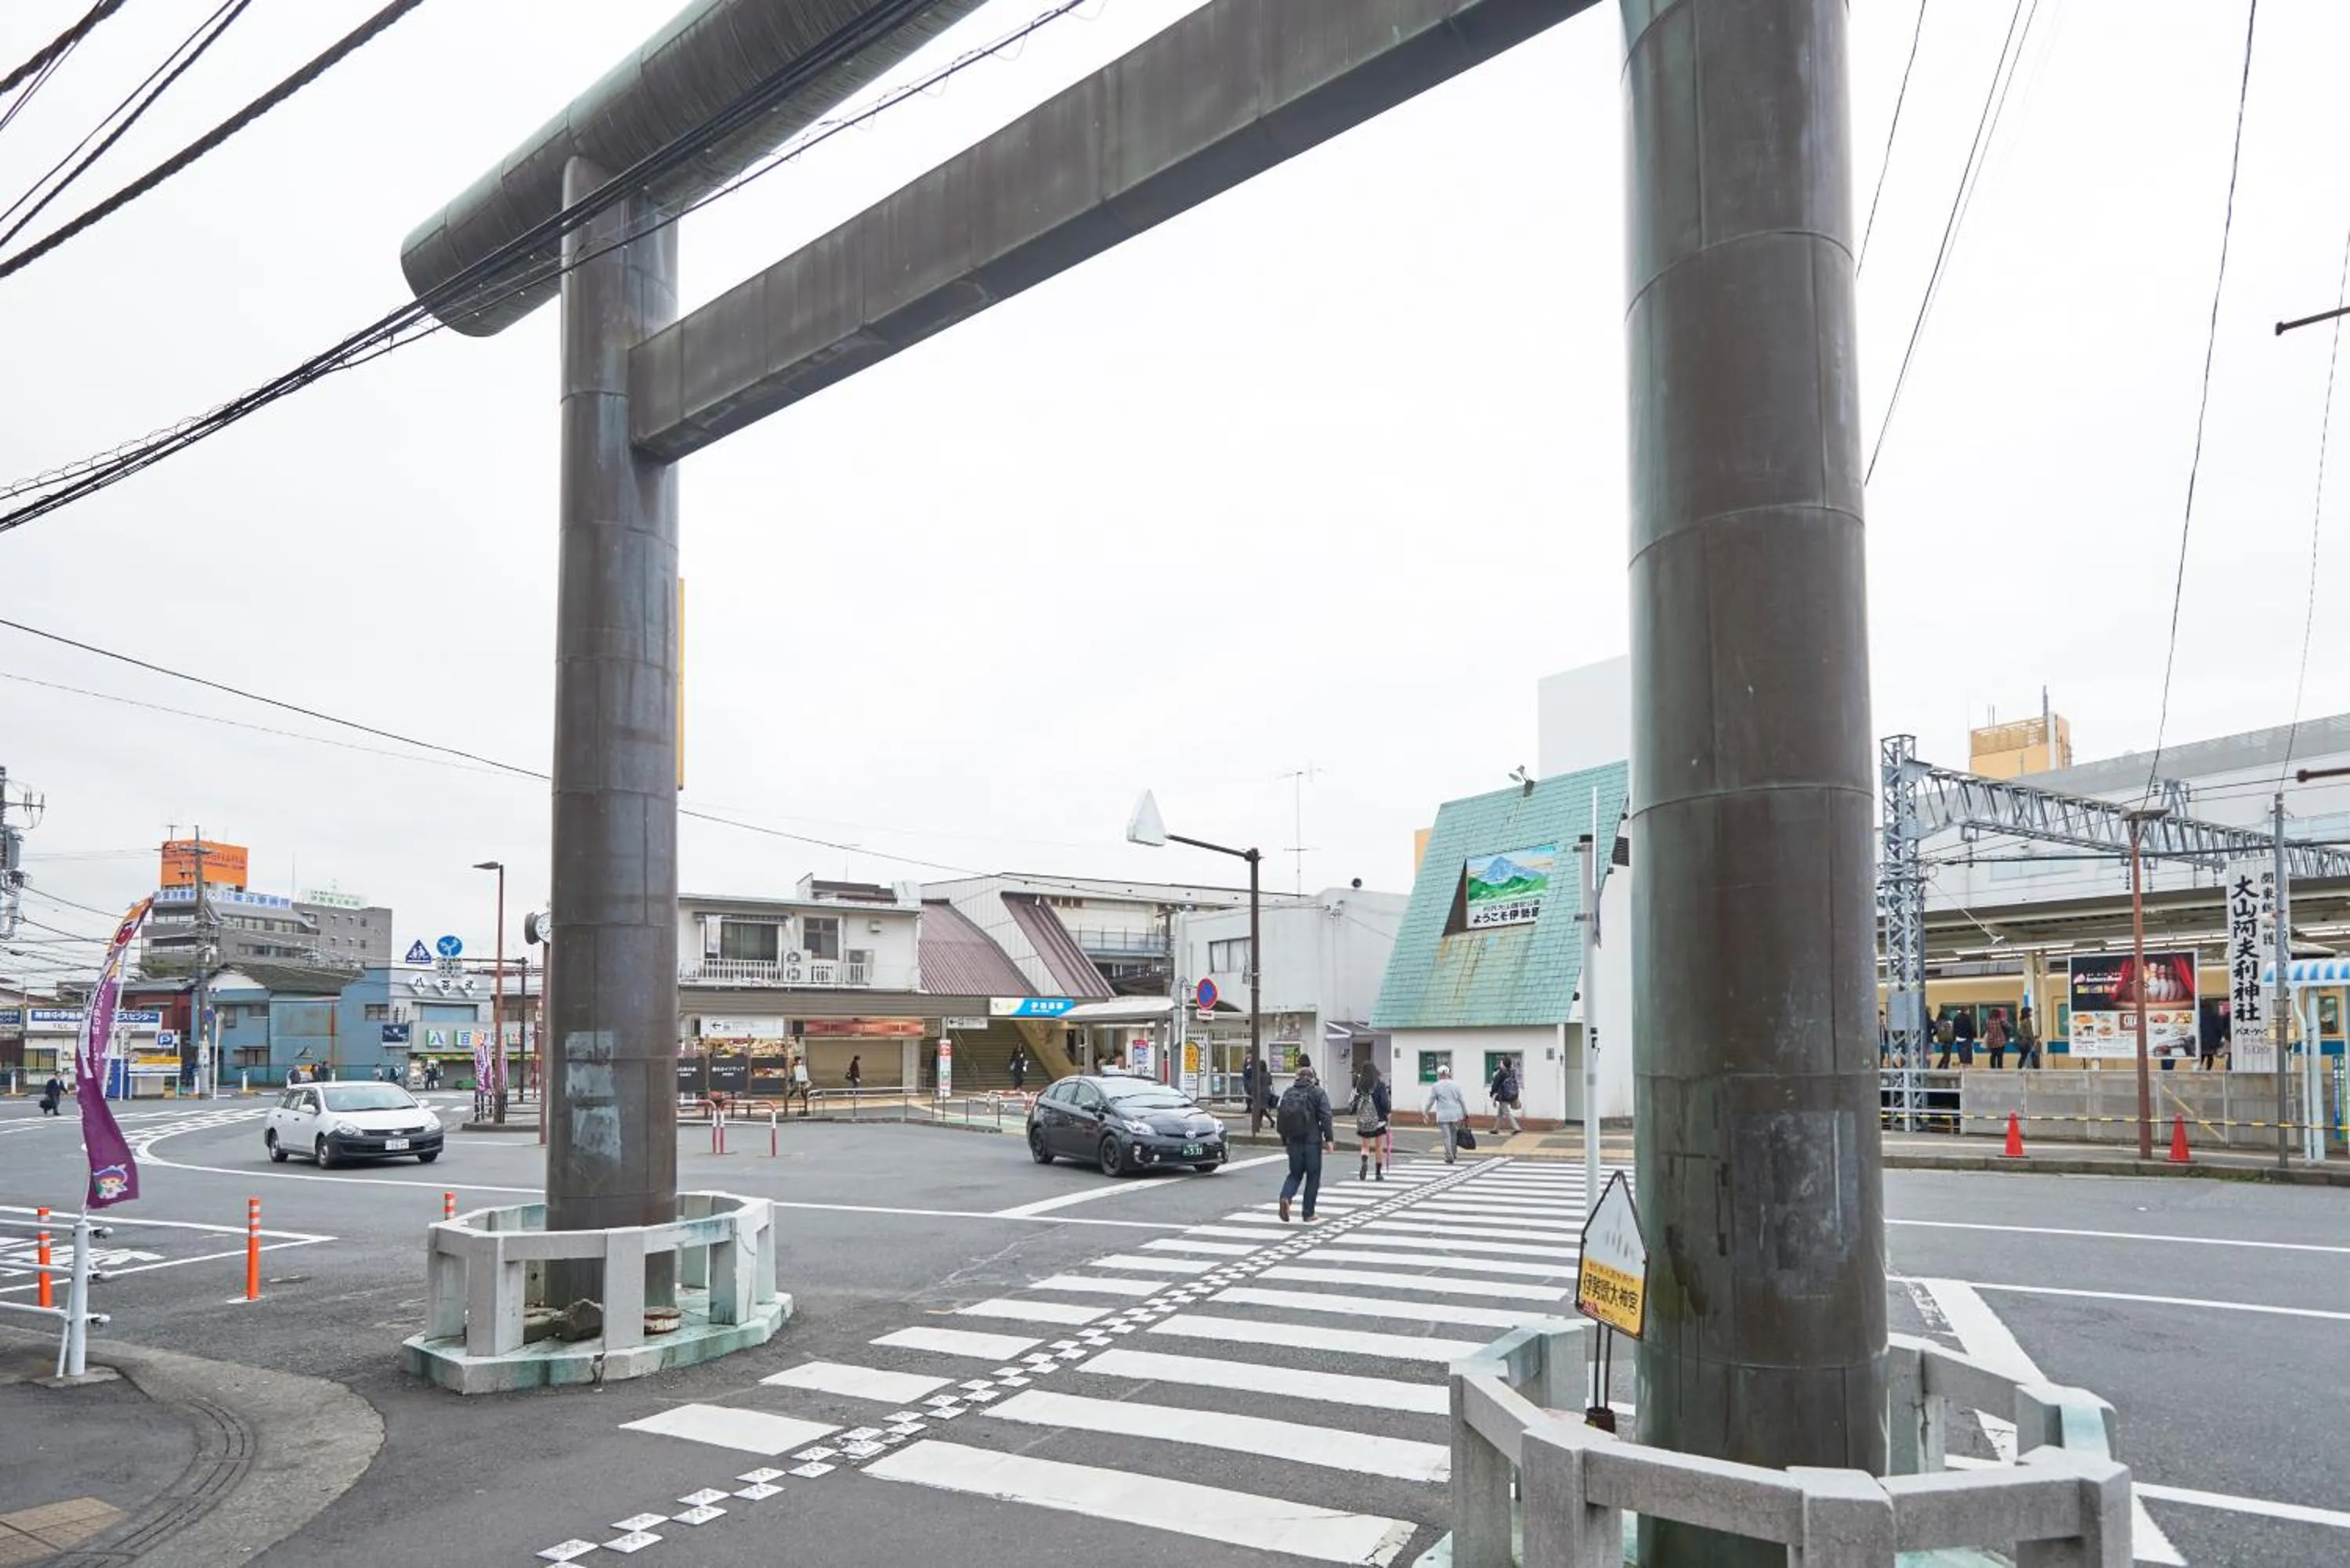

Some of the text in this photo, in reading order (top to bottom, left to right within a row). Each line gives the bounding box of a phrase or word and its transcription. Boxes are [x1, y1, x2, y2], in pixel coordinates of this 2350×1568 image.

[2231, 874, 2260, 1022] 大山阿夫利神社
